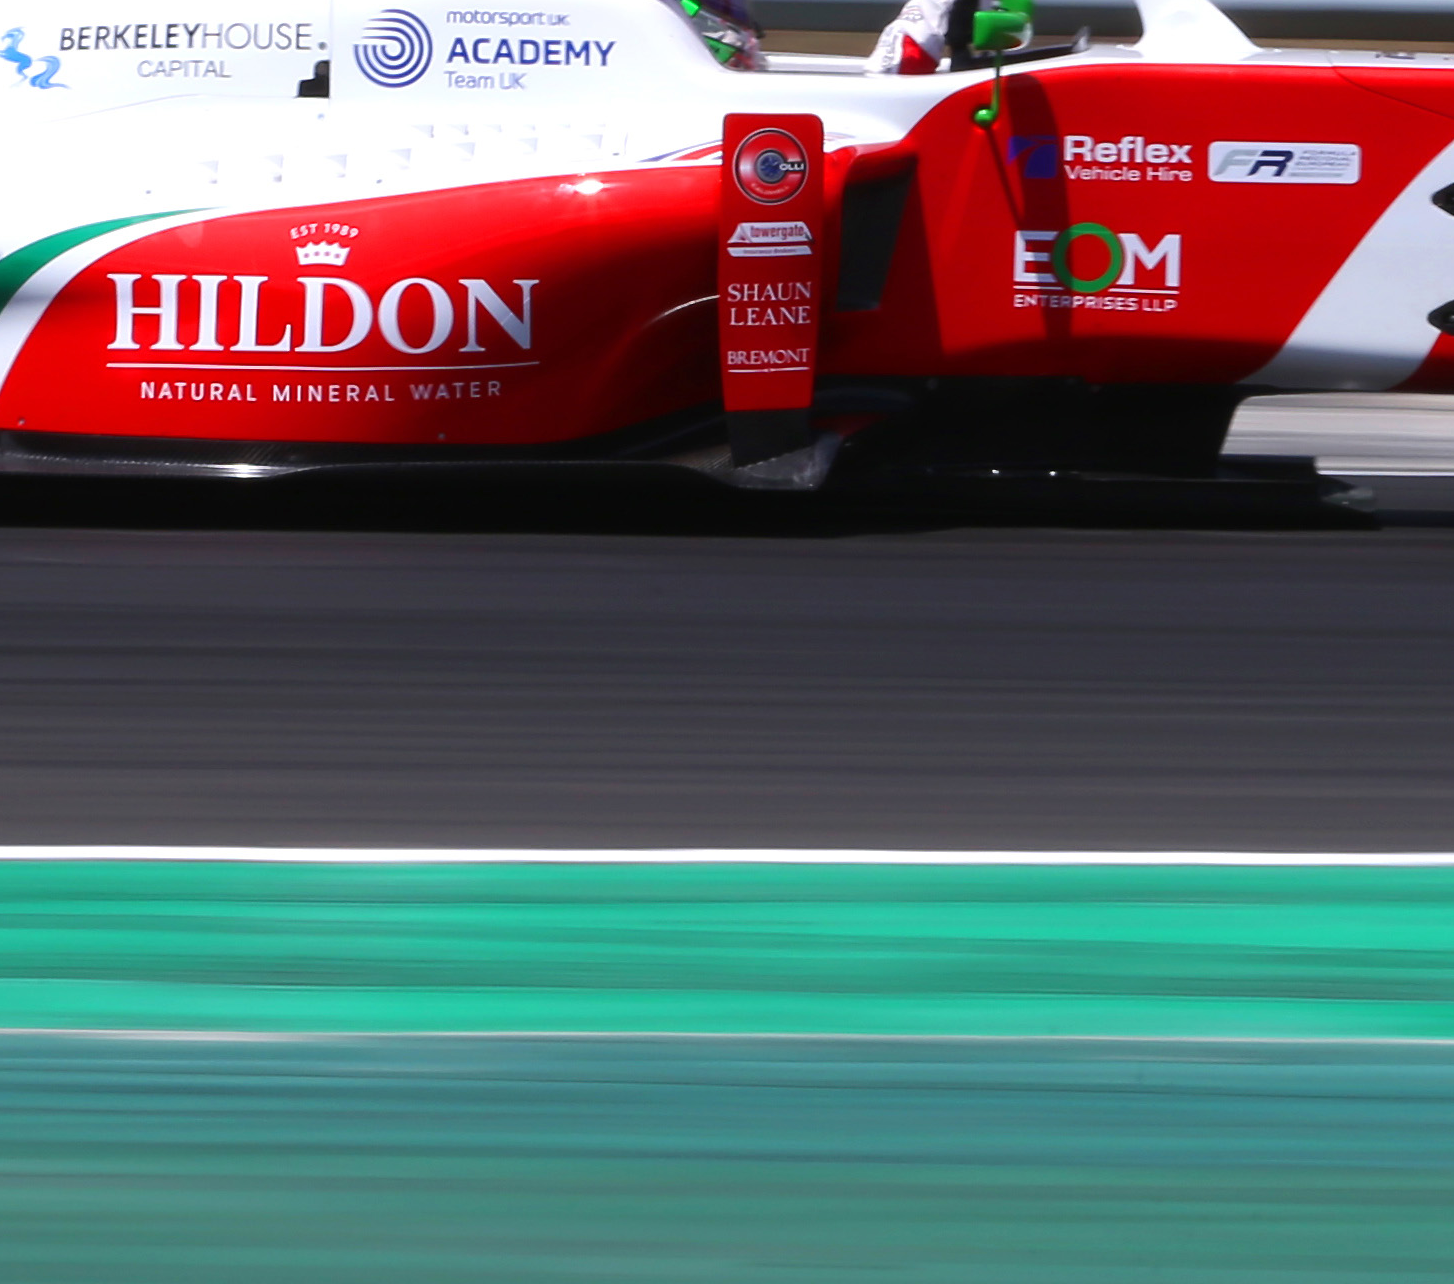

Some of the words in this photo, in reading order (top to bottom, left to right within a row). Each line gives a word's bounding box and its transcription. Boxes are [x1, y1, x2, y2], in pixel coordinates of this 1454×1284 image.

[446, 9, 545, 27] motorsport
[446, 37, 617, 67] ACADEMY
[137, 60, 232, 78] CAPITAL
[444, 70, 495, 90] Team
[499, 72, 527, 91] UK
[1063, 135, 1193, 164] Reflex
[1064, 165, 1142, 181] Vehicle
[1146, 166, 1193, 182] Hire
[1213, 149, 1294, 177] FR
[290, 222, 318, 239] EST
[324, 222, 359, 238] 1989
[1013, 222, 1182, 293] EOM
[727, 281, 812, 302] SHAUN
[1013, 294, 1139, 311] ENTERPRISES
[1142, 298, 1179, 312] LLP
[106, 273, 540, 355] HILDON
[729, 305, 811, 326] LEANE
[727, 347, 811, 365] BREMONT
[140, 381, 257, 402] NATURAL
[272, 384, 396, 402] MINERAL
[409, 381, 501, 400] WATER
